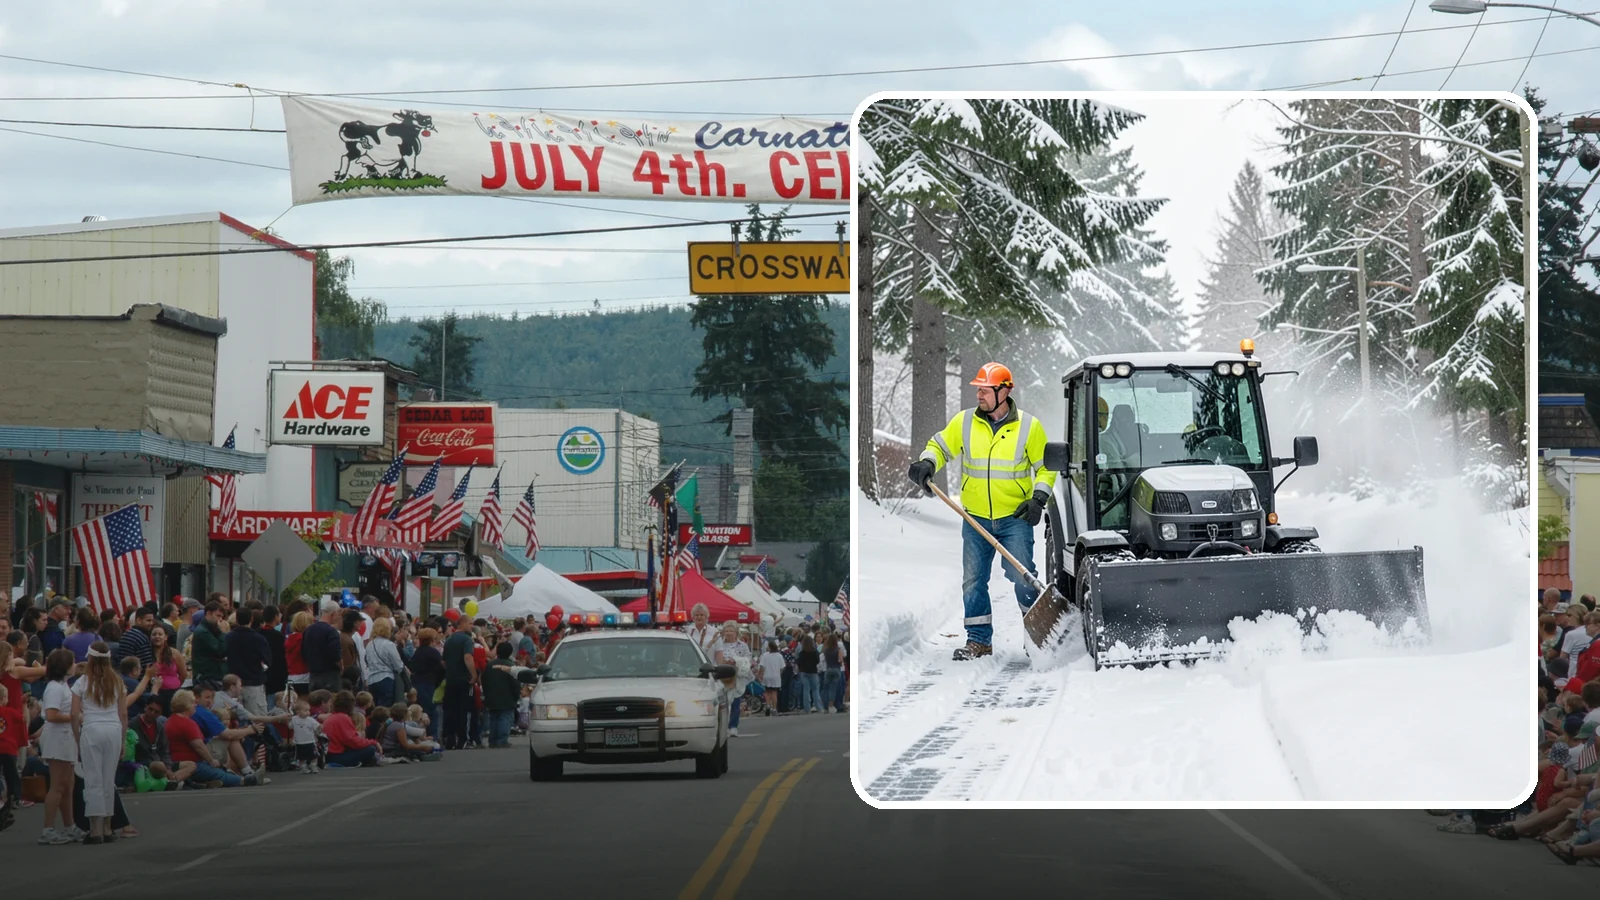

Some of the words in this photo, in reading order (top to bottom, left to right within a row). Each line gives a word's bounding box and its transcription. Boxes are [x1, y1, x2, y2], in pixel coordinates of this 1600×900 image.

[481, 141, 605, 192] JULY
[632, 150, 746, 197] 4th.
[697, 254, 850, 280] CROSSWA
[282, 380, 373, 420] ACE
[405, 409, 452, 422] CEDAR
[283, 421, 371, 436] Hardware
[416, 428, 476, 447] Coca-Cola
[83, 485, 94, 494] St.
[96, 485, 124, 495] Vincent
[126, 485, 136, 495] de
[138, 485, 155, 496] Paul
[688, 526, 741, 535] CRNATION
[699, 535, 730, 543] GLASS
